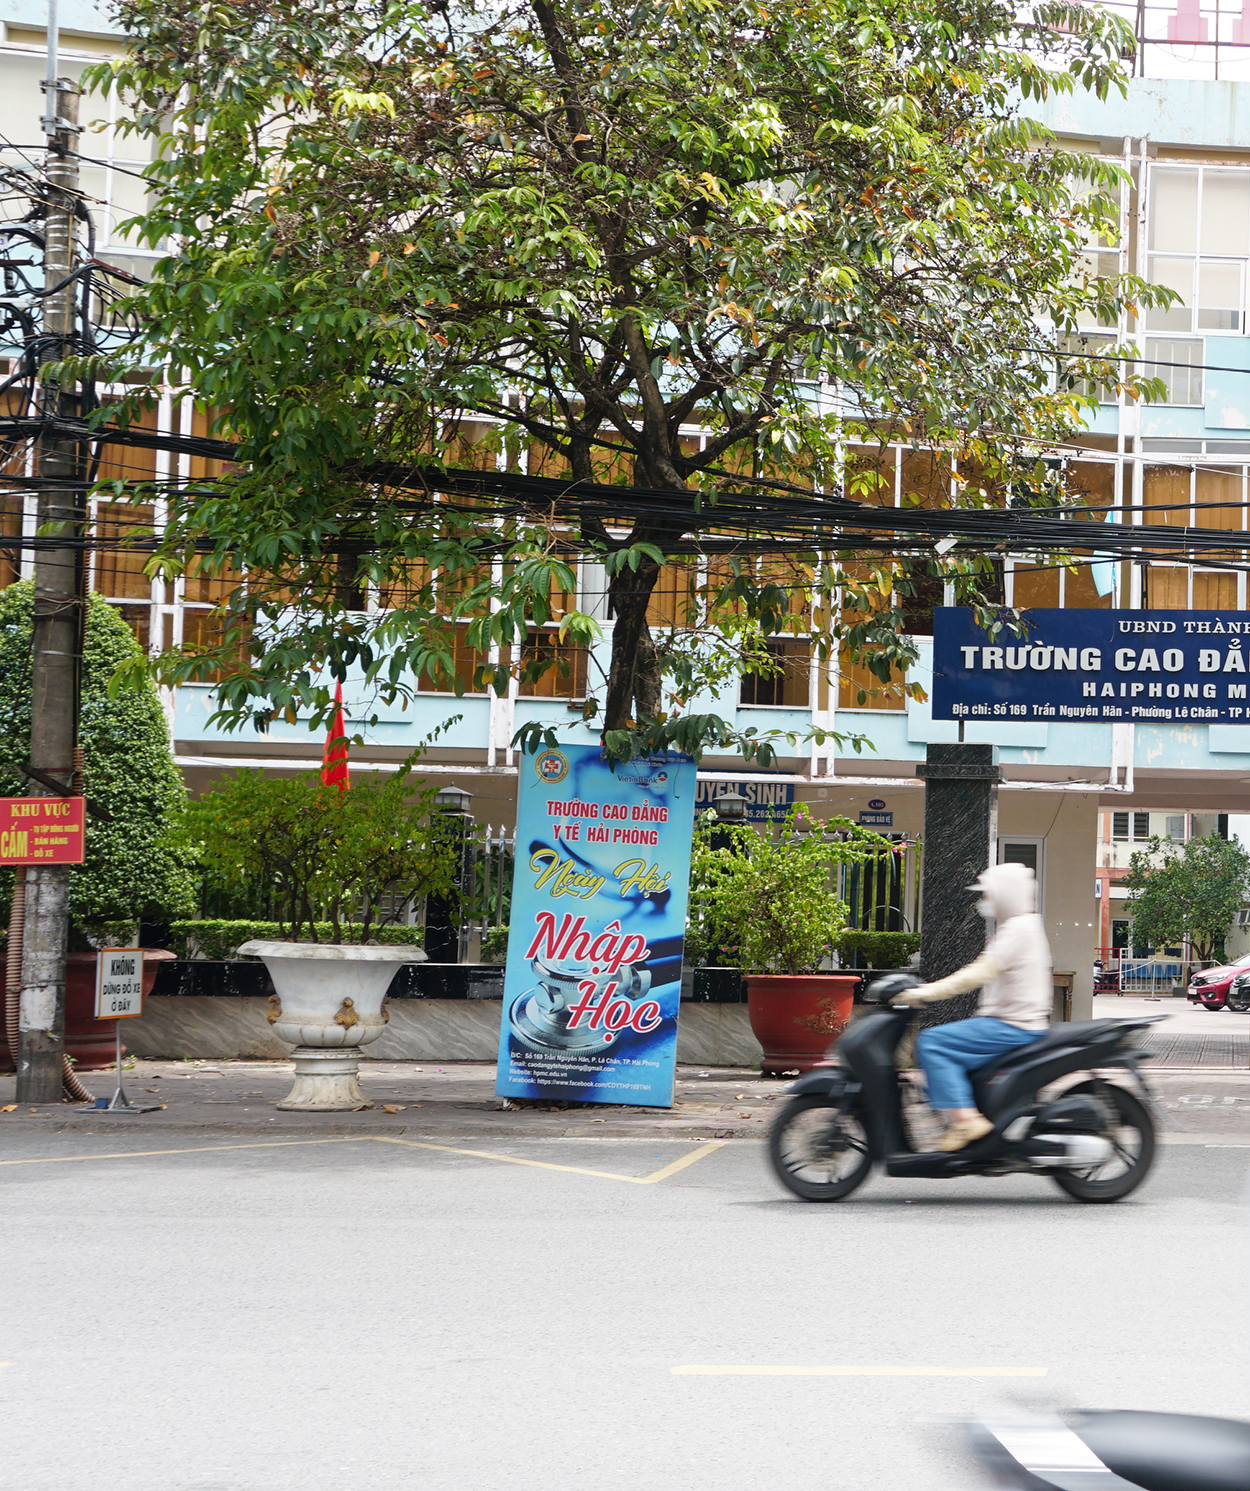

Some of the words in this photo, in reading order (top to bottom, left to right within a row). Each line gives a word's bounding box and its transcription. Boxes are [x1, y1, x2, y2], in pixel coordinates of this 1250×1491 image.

[1119, 620, 1177, 634] UBND
[960, 640, 1101, 671] TRƯỜNG
[1114, 647, 1185, 672] CAO
[1082, 681, 1217, 699] HAIPHONG
[952, 703, 969, 718] Địa
[993, 701, 1008, 715] Số
[1009, 704, 1027, 715] 169
[1033, 702, 1056, 716] Trần
[1060, 705, 1099, 718] Nguyên
[1131, 705, 1172, 719] Phường
[1175, 706, 1188, 717] Lê
[1190, 706, 1219, 718] Chân
[1229, 707, 1243, 718] TP
[617, 774, 658, 784] VietinBank
[745, 783, 787, 805] SINH
[10, 803, 40, 817] KHU
[43, 802, 71, 818] VỰC
[547, 799, 598, 818] TRƯỜNG
[602, 805, 628, 820] CAO
[632, 799, 668, 822] ĐẲNG
[1, 821, 28, 858] CẤM
[34, 836, 48, 845] BÁN
[50, 836, 68, 845] HÀNG
[553, 825, 561, 840] Y
[565, 821, 582, 841] TẾ
[587, 823, 609, 842] HẢI
[613, 825, 658, 845] PHÒNG
[45, 849, 54, 857] XE
[529, 848, 605, 899] Ngày
[613, 859, 672, 898] Hội
[525, 911, 651, 975] Nhập
[111, 955, 135, 976] KHÔNG
[103, 981, 121, 995] DỪNG
[122, 978, 131, 994] ĐỖ
[133, 982, 140, 993] XE
[118, 998, 131, 1011] ĐÂY
[567, 981, 662, 1043] Học
